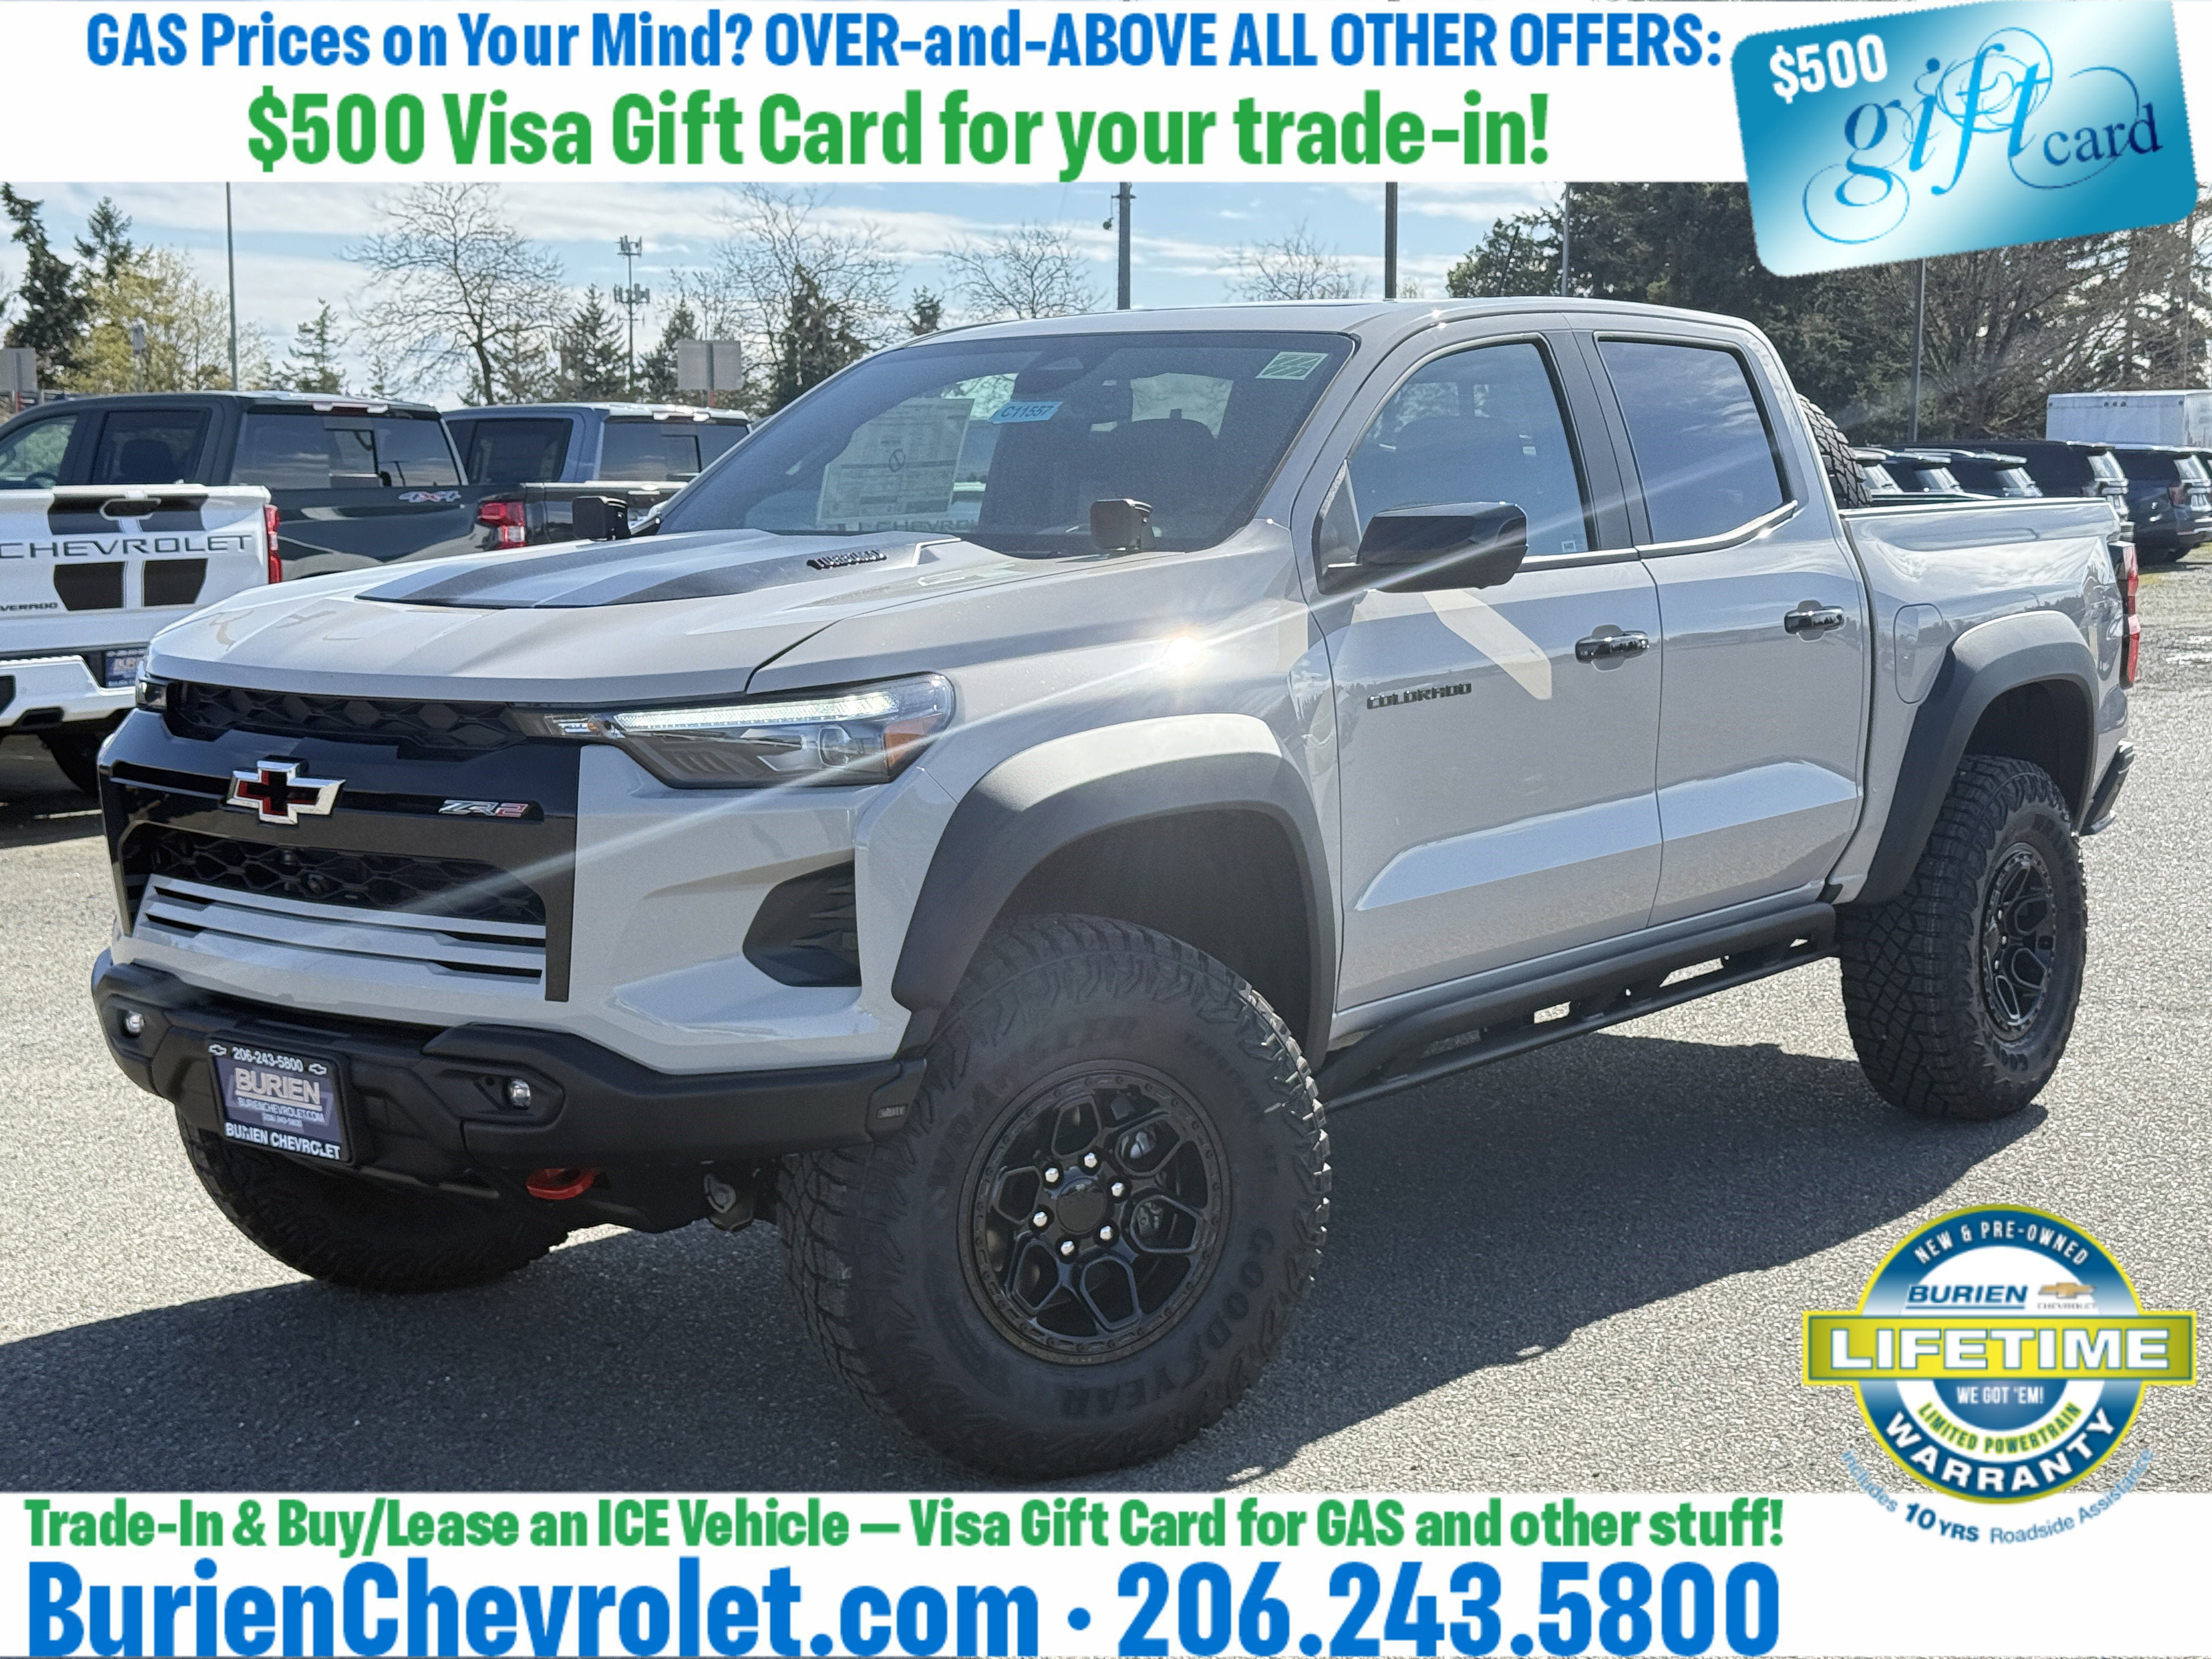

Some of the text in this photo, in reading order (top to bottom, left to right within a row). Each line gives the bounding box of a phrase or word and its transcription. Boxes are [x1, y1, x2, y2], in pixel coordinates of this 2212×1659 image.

[1001, 405, 1054, 418] C11557
[0, 534, 252, 559] CHEVROLET
[438, 799, 529, 818] ZR2
[232, 1046, 304, 1073] 206-243-5800
[234, 1067, 320, 1105] BURIEN
[225, 1122, 341, 1160] BURIEN CHEVROLET
